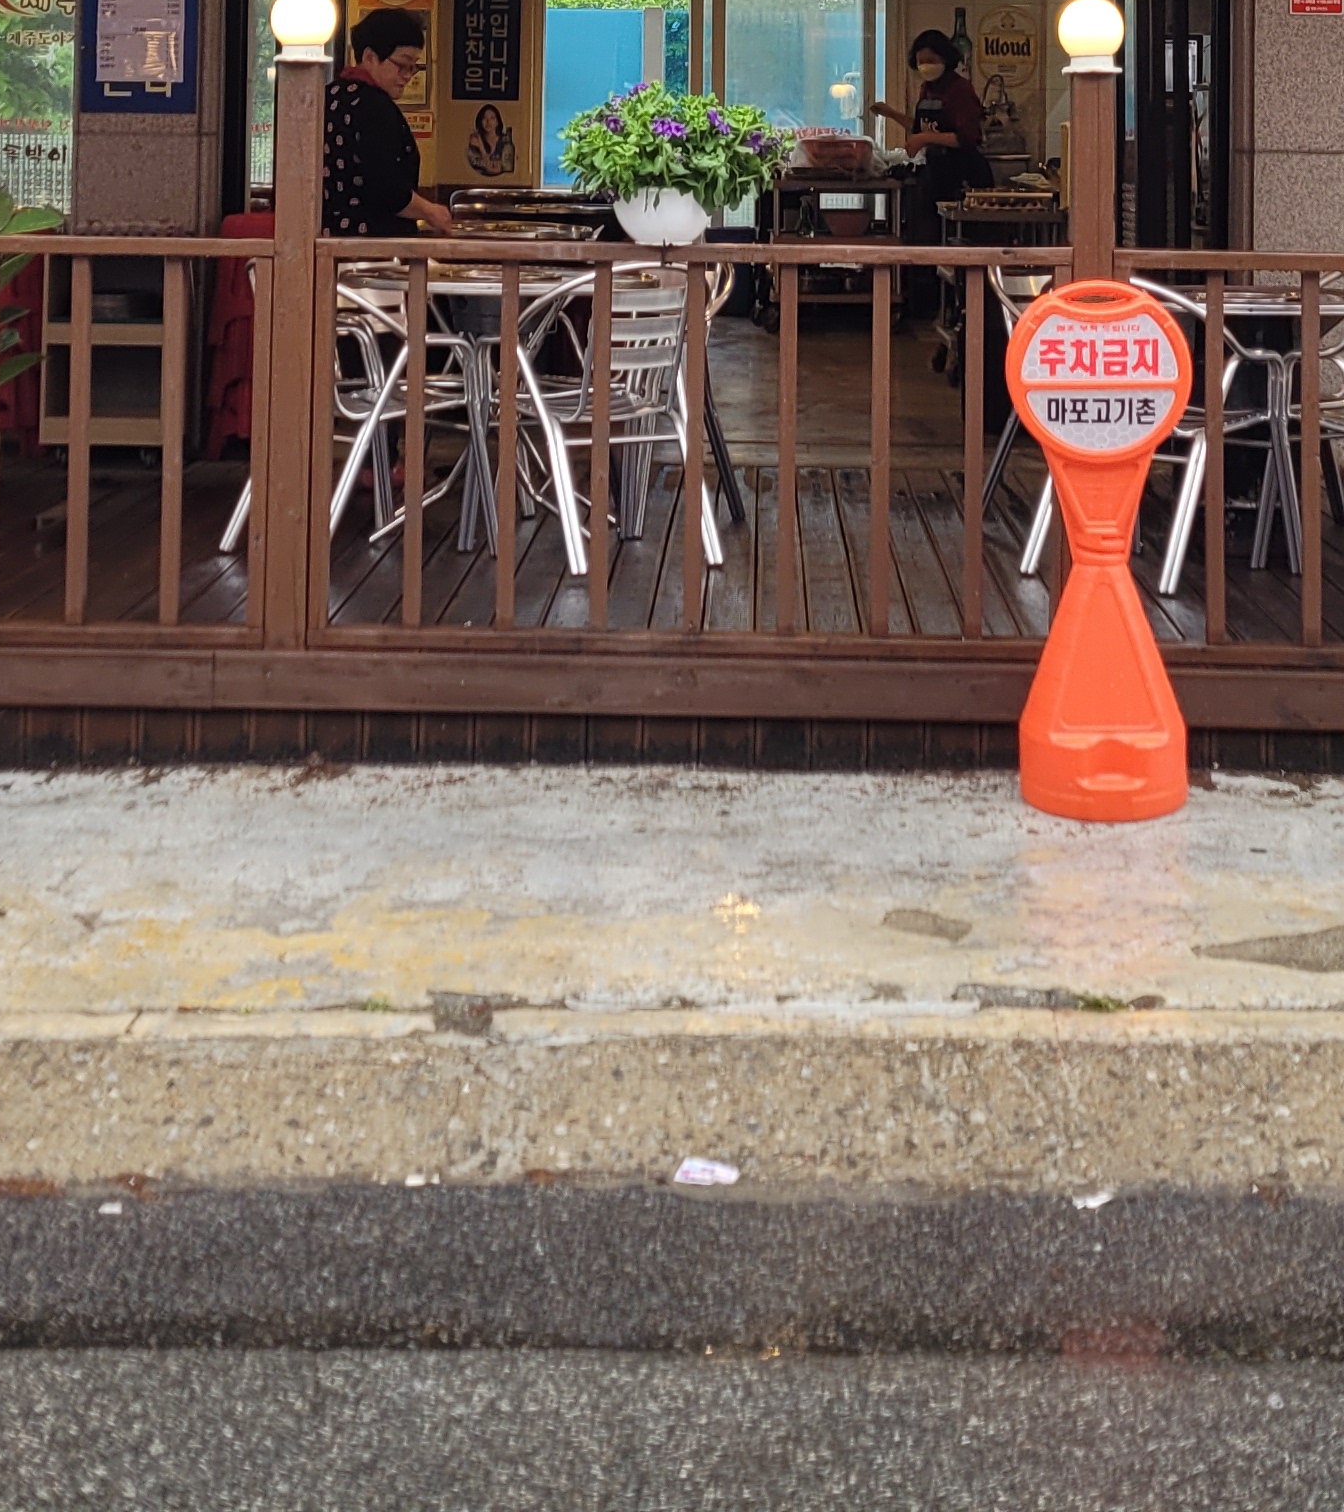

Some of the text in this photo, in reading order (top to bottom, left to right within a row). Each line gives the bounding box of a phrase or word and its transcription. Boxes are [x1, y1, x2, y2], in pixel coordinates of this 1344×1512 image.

[984, 36, 1032, 57] Kloud
[1038, 338, 1159, 377] 주차금지
[1046, 397, 1156, 425] 마포고기촌
